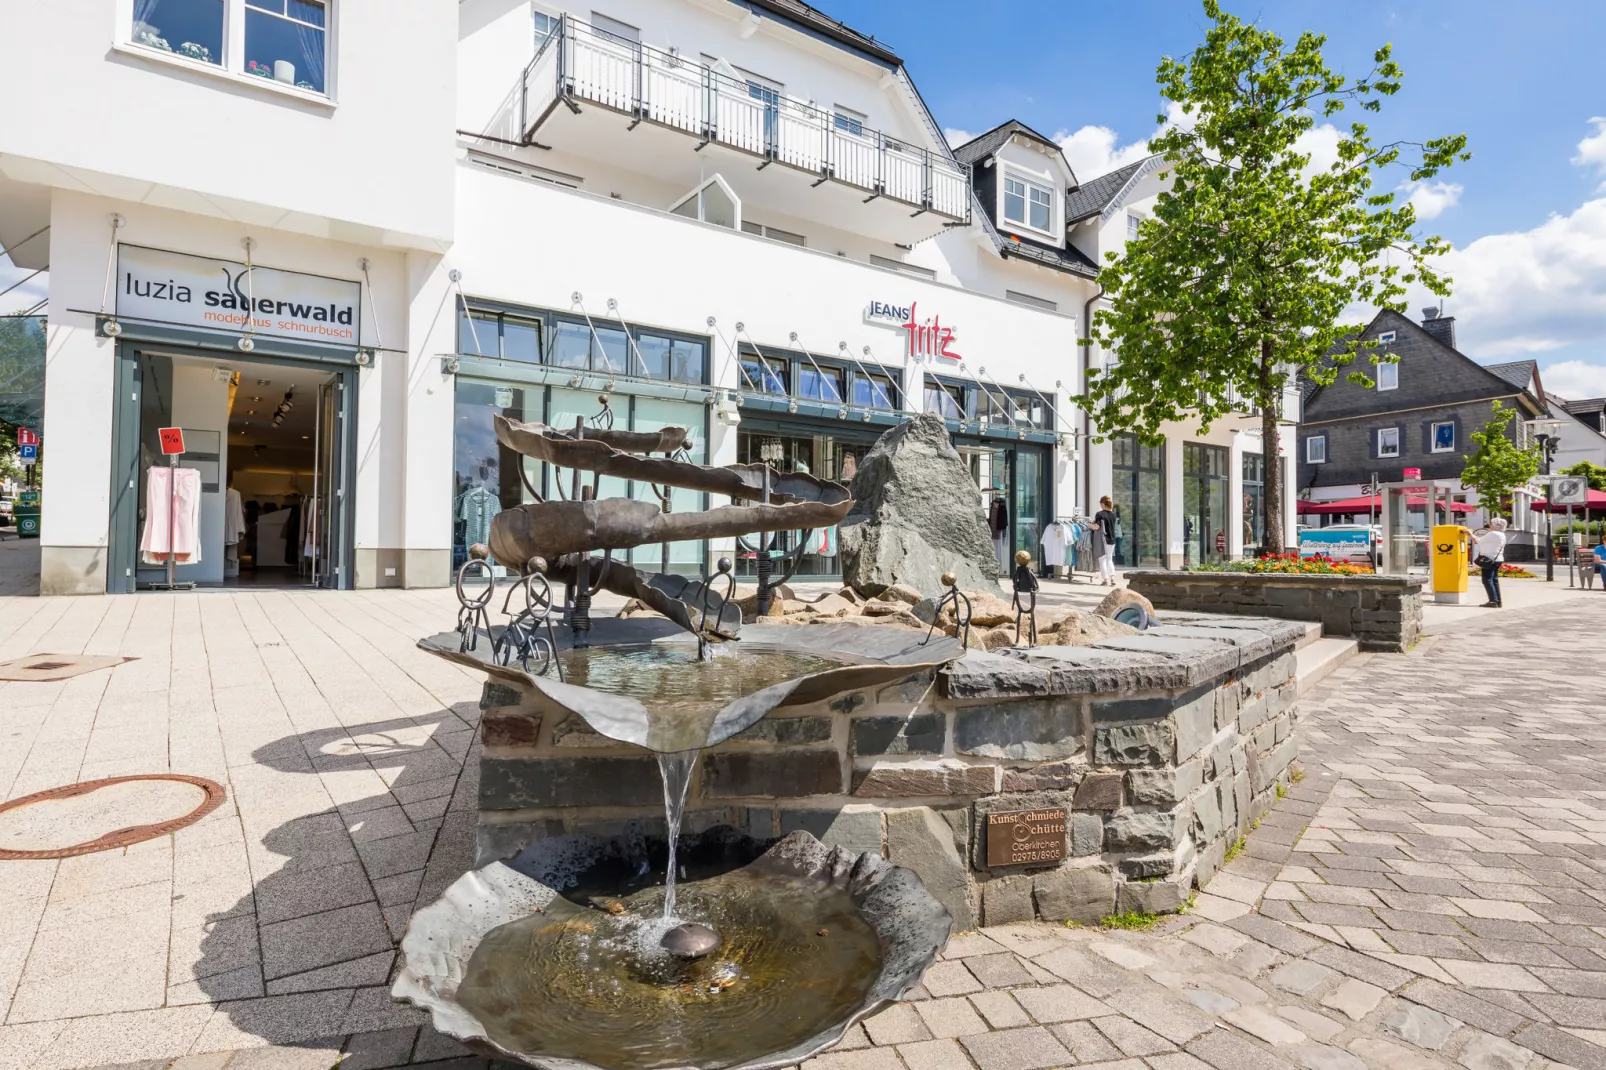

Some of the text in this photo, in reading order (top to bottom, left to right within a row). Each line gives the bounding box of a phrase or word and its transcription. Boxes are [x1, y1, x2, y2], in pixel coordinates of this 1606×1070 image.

[126, 273, 353, 326] luzia sauerwald
[870, 300, 910, 320] JEANS
[203, 311, 353, 339] modehaus schnurbusch
[902, 301, 962, 360] fritz
[1011, 841, 1061, 852] Oberkirchen
[1011, 850, 1061, 862] 02975/8905
